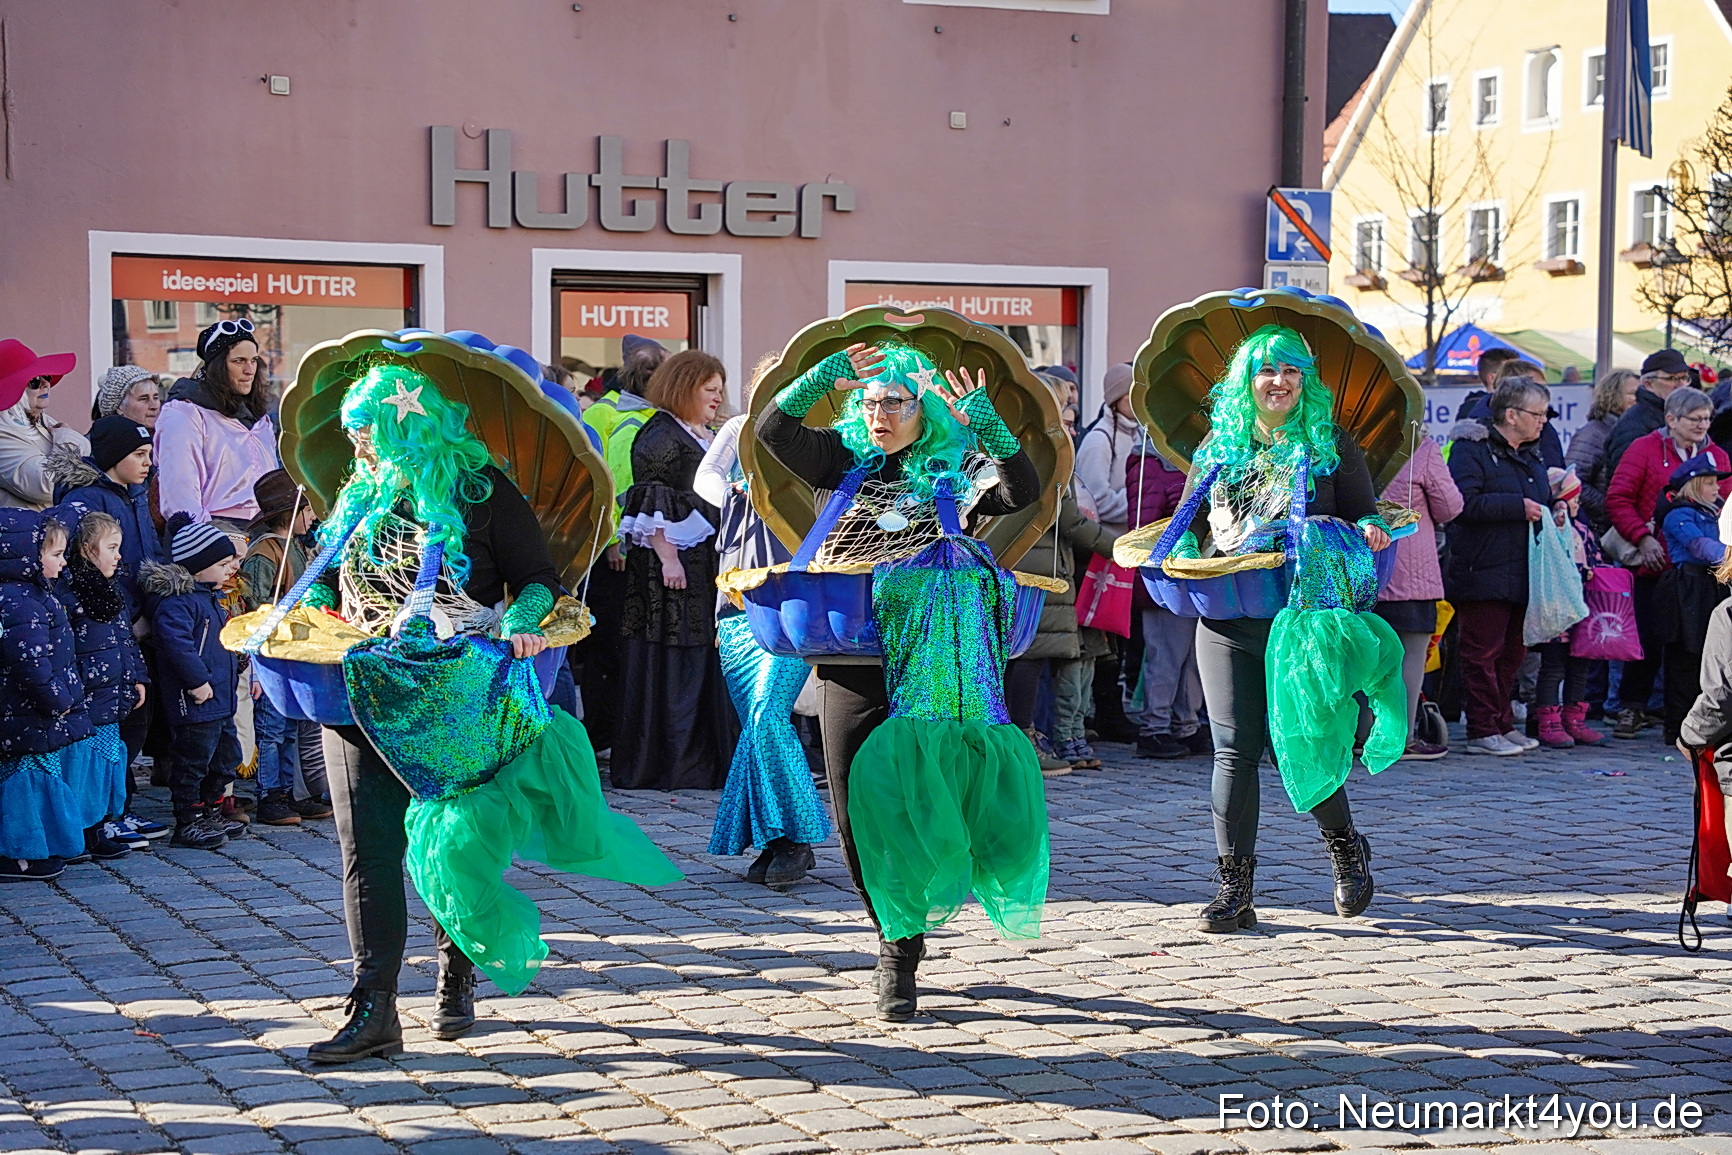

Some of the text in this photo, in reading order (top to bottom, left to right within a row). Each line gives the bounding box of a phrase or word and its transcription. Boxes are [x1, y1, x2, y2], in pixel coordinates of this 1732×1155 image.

[430, 125, 856, 239] Hutter
[1277, 199, 1313, 253] P
[162, 269, 357, 297] idee+spiel HUTTER
[580, 304, 670, 328] HUTTER
[960, 296, 1033, 316] HUTTER
